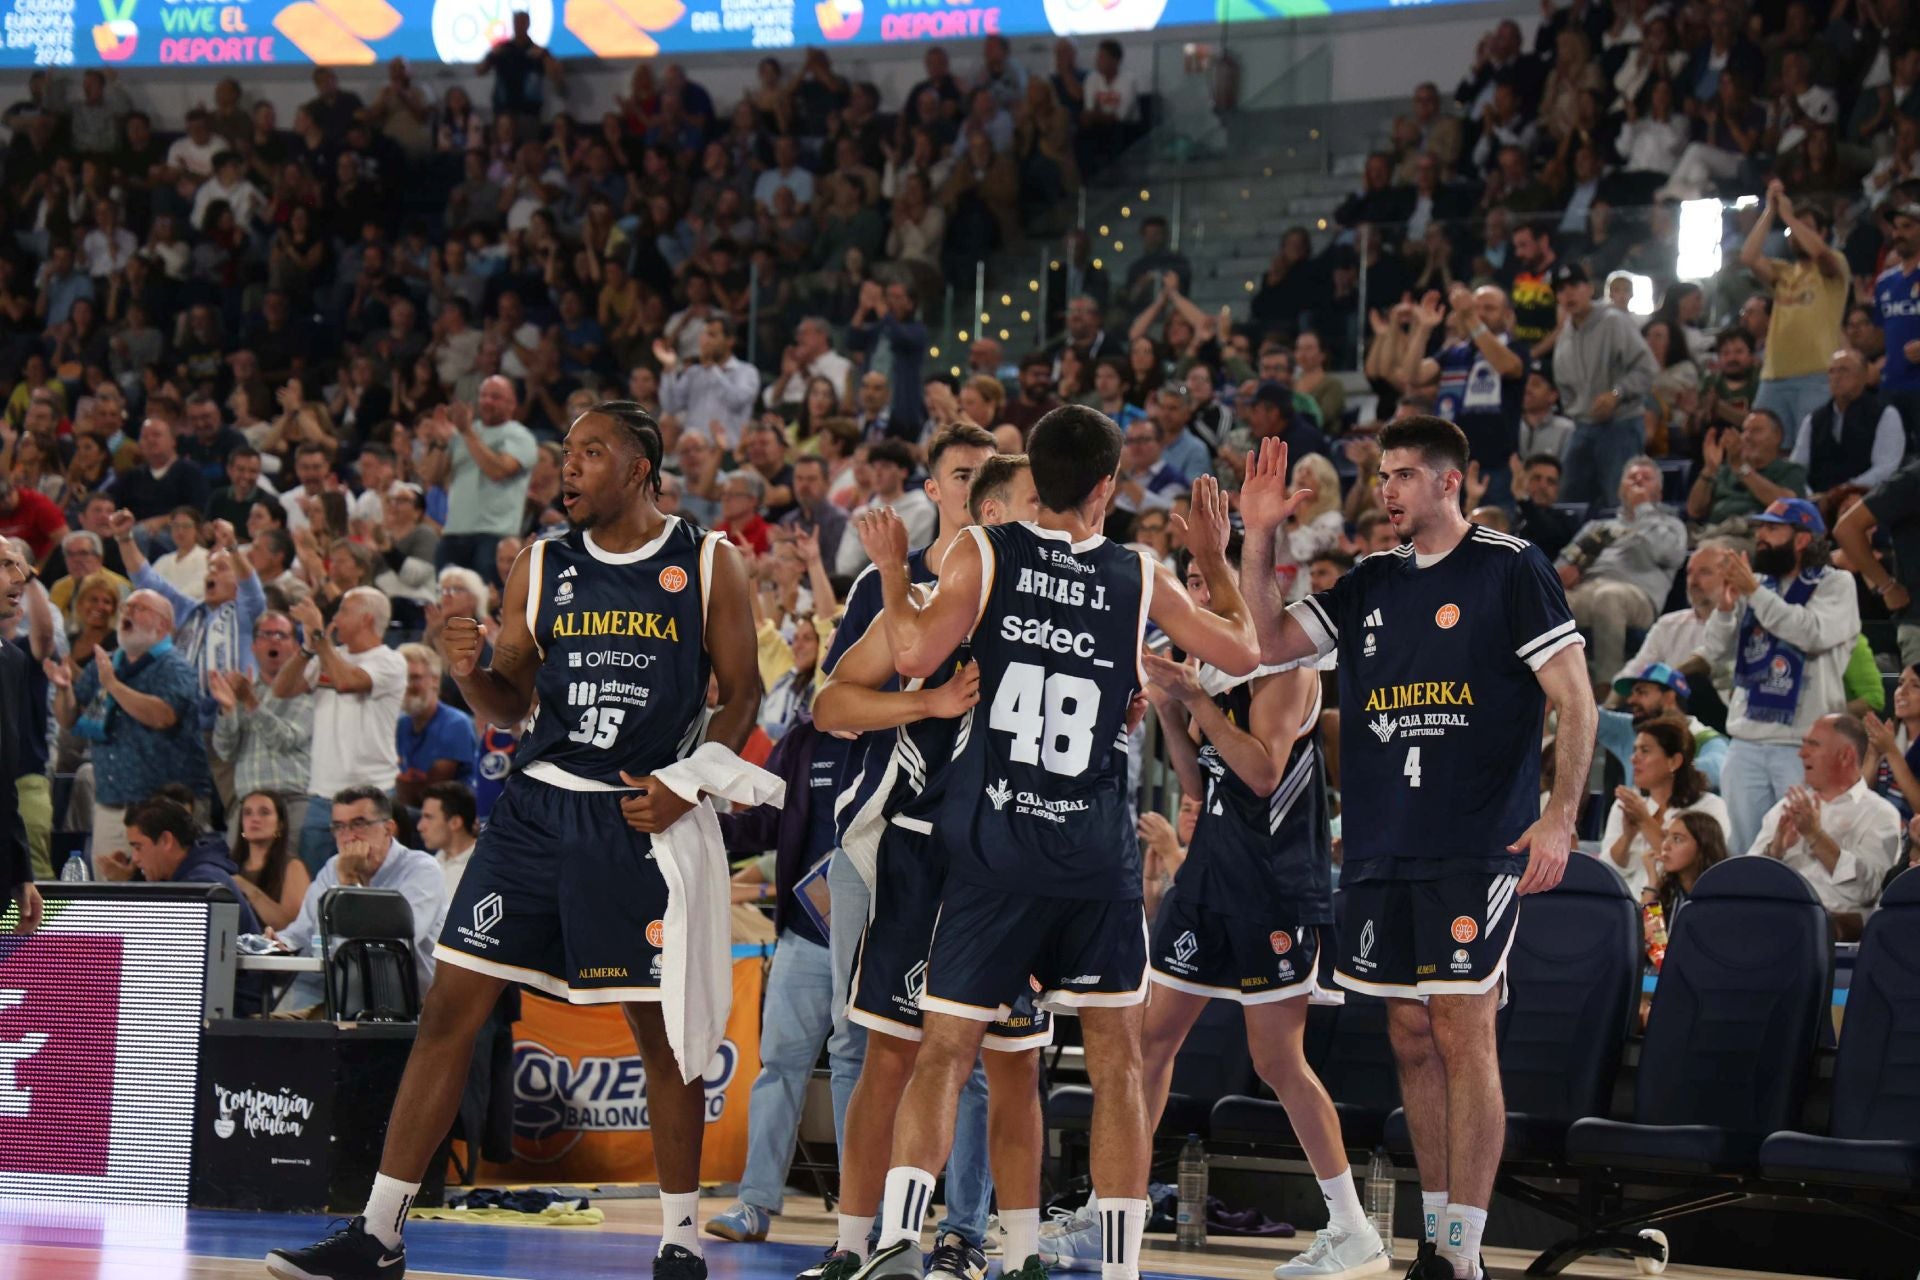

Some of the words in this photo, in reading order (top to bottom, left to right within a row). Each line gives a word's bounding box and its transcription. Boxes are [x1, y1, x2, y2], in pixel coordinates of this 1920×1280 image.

[160, 6, 216, 32] VIVE
[220, 5, 249, 32] EL
[880, 7, 1000, 40] DEPORTE
[160, 36, 275, 64] DEPORTE
[1016, 568, 1085, 606] ARIAS
[1091, 585, 1111, 611] J.
[553, 610, 679, 642] ALIMERKA
[1365, 681, 1475, 712] ALIMERKA
[568, 706, 626, 750] 35
[989, 661, 1101, 777] 48
[1399, 715, 1421, 727] CAJA
[1424, 714, 1469, 727] RURAL
[1408, 728, 1445, 737] ASTURIAS
[1403, 746, 1422, 788] 4
[1015, 806, 1030, 814] DE
[1016, 792, 1043, 806] CAJ
[463, 937, 488, 949] OVIEDO
[474, 932, 500, 946] MOTOR
[579, 967, 628, 979] ALIMERKA
[516, 1040, 738, 1102] OVIEO
